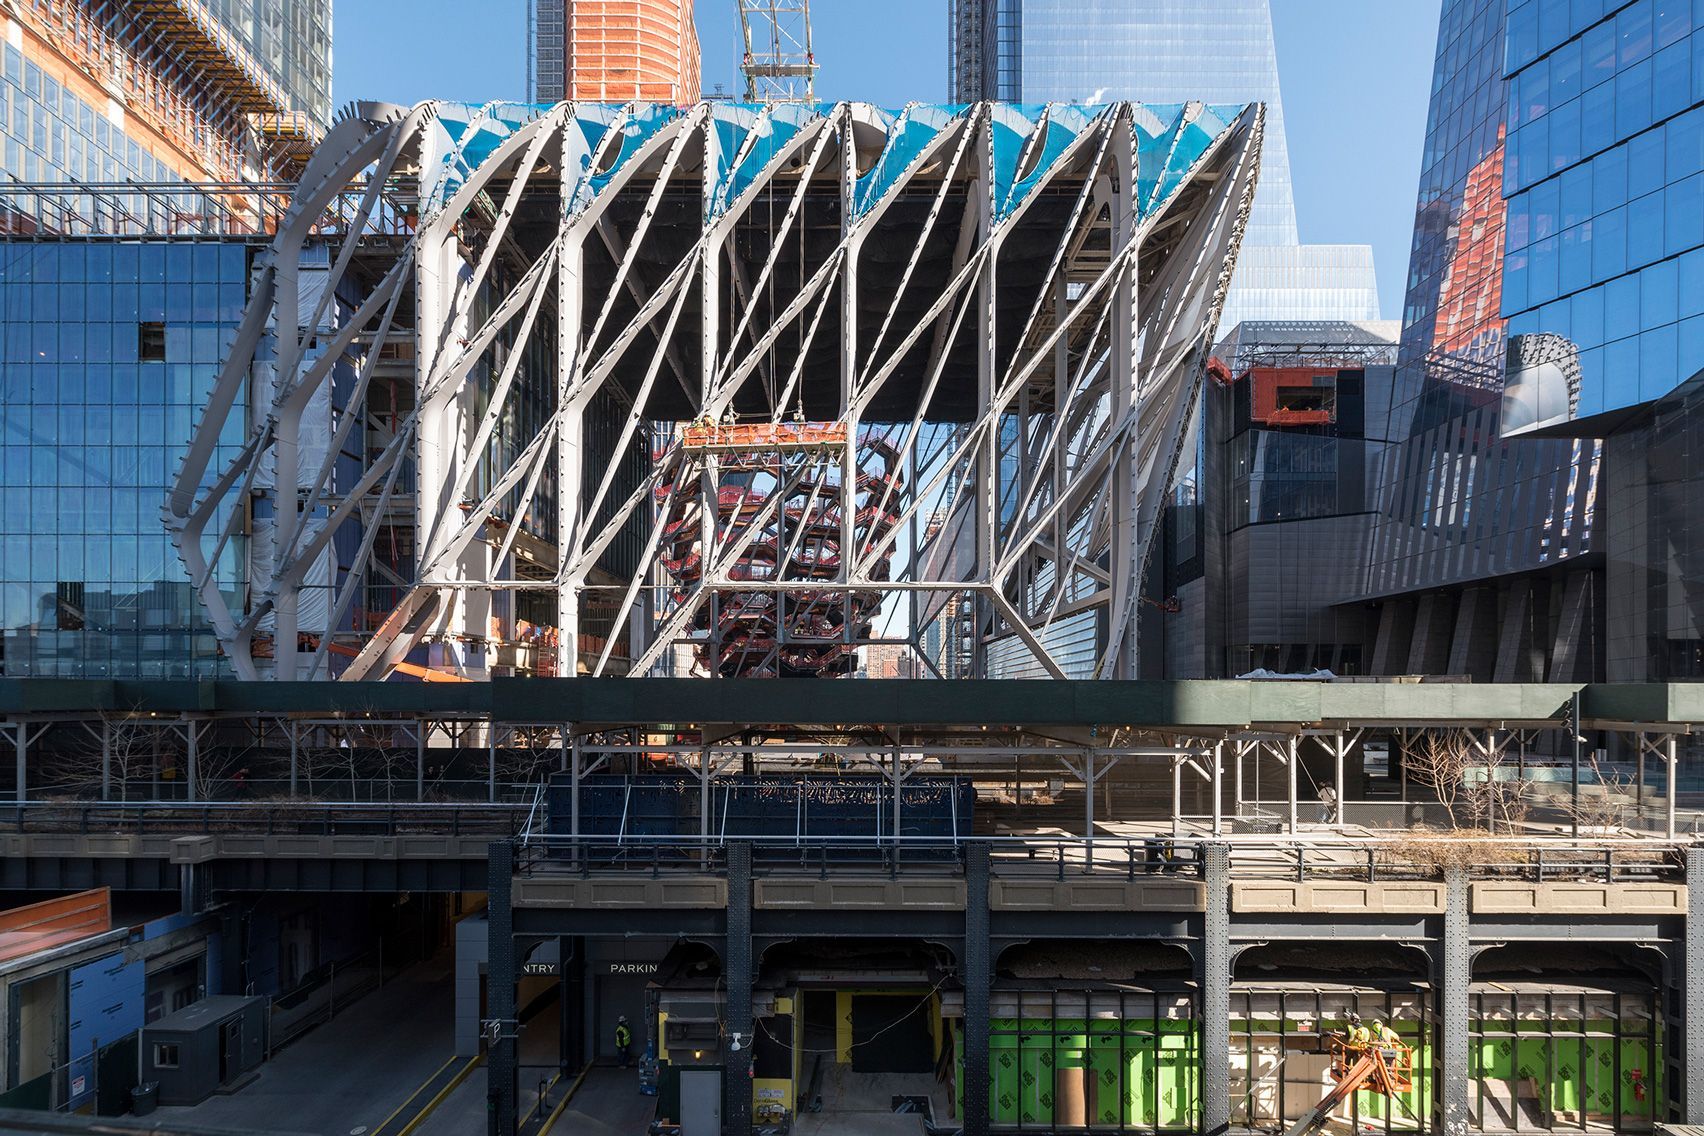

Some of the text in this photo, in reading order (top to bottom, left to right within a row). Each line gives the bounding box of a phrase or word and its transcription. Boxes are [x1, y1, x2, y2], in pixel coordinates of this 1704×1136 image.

[523, 964, 554, 973] NTRY
[610, 964, 659, 973] PARKIN
[493, 1023, 501, 1039] P
